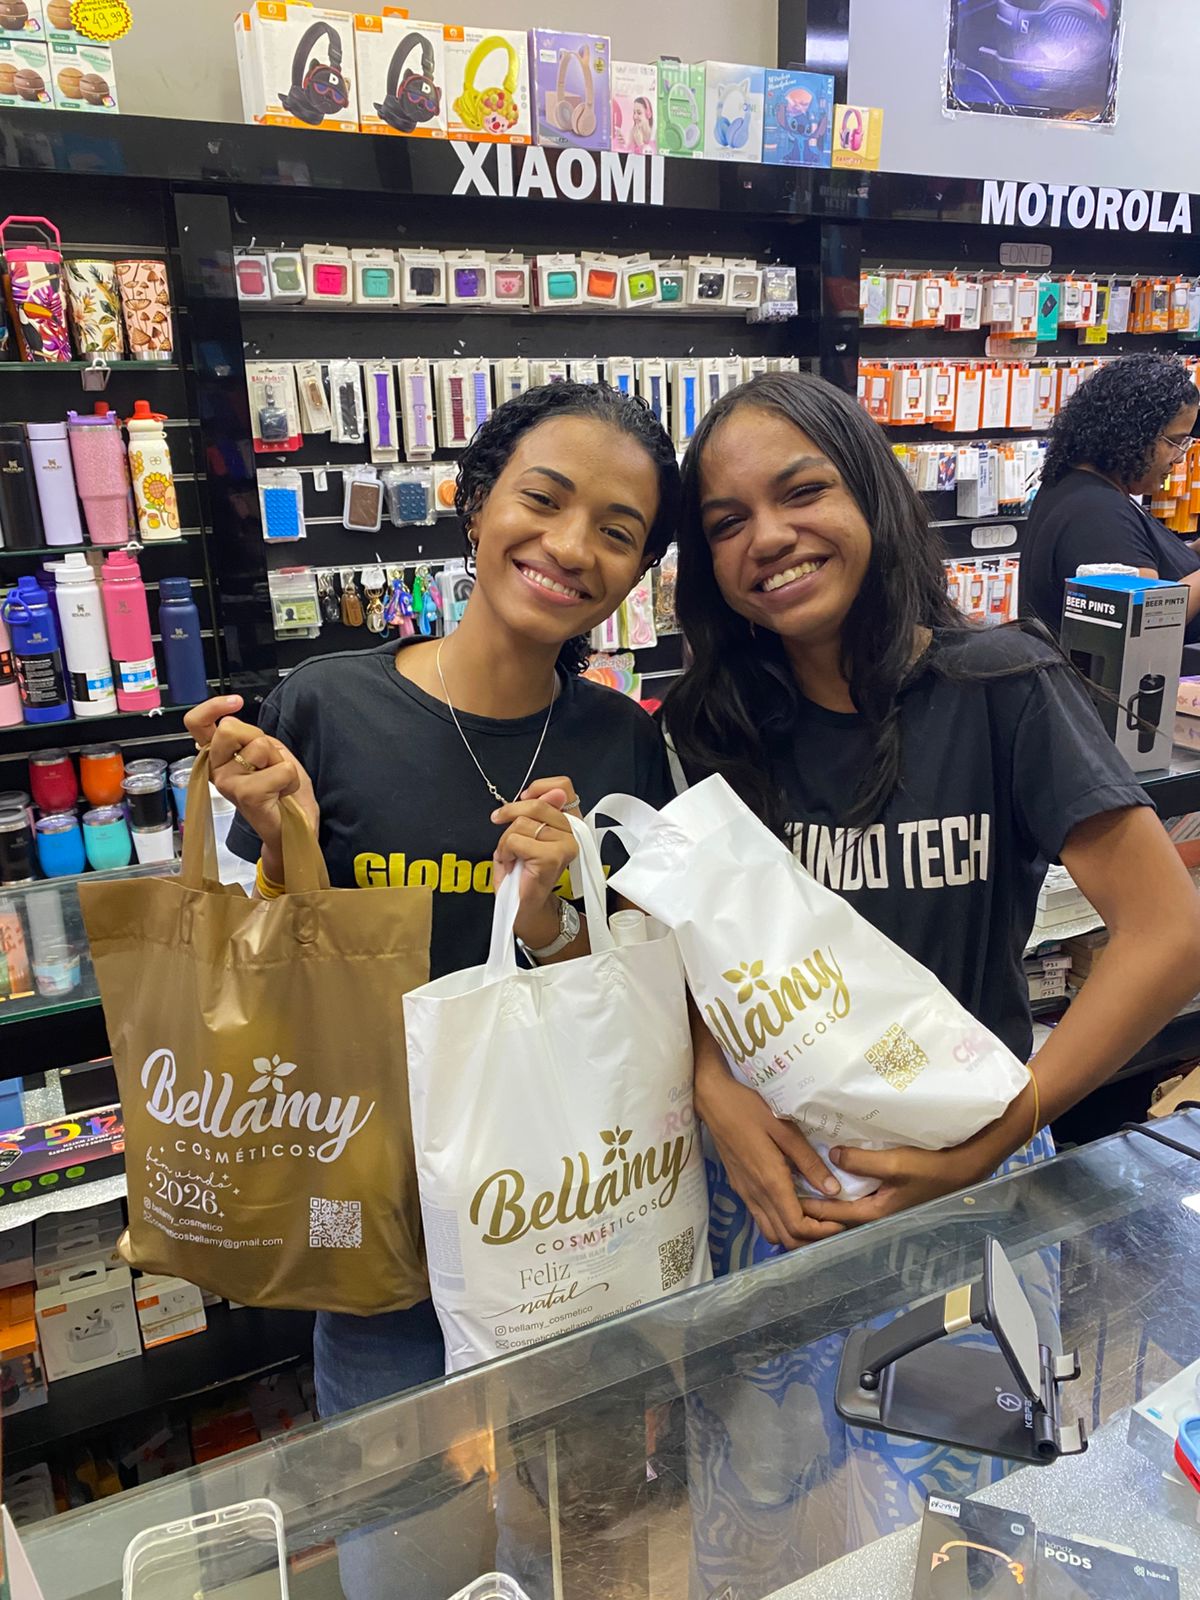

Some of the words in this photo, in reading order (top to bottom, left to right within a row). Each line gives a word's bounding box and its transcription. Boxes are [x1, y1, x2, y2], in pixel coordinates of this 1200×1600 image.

[450, 140, 665, 206] XIAOMI
[980, 180, 1192, 234] MOTOROLA
[1066, 595, 1087, 610] BEER
[1088, 600, 1116, 615] PINTS
[1145, 599, 1163, 608] BEER
[1164, 597, 1185, 606] PINTS
[897, 812, 991, 890] TECH
[141, 1048, 376, 1163] Bellamy
[175, 1140, 317, 1164] COSMÉTICOS
[155, 1171, 218, 1215] 2026
[469, 1135, 693, 1246] Bellamy
[535, 1198, 658, 1255] COSMÉTICOS
[519, 1261, 571, 1290] Feliz
[481, 1281, 610, 1320] natal
[508, 1304, 593, 1334] bellamy_cosmetico
[1044, 1547, 1093, 1570] PODS
